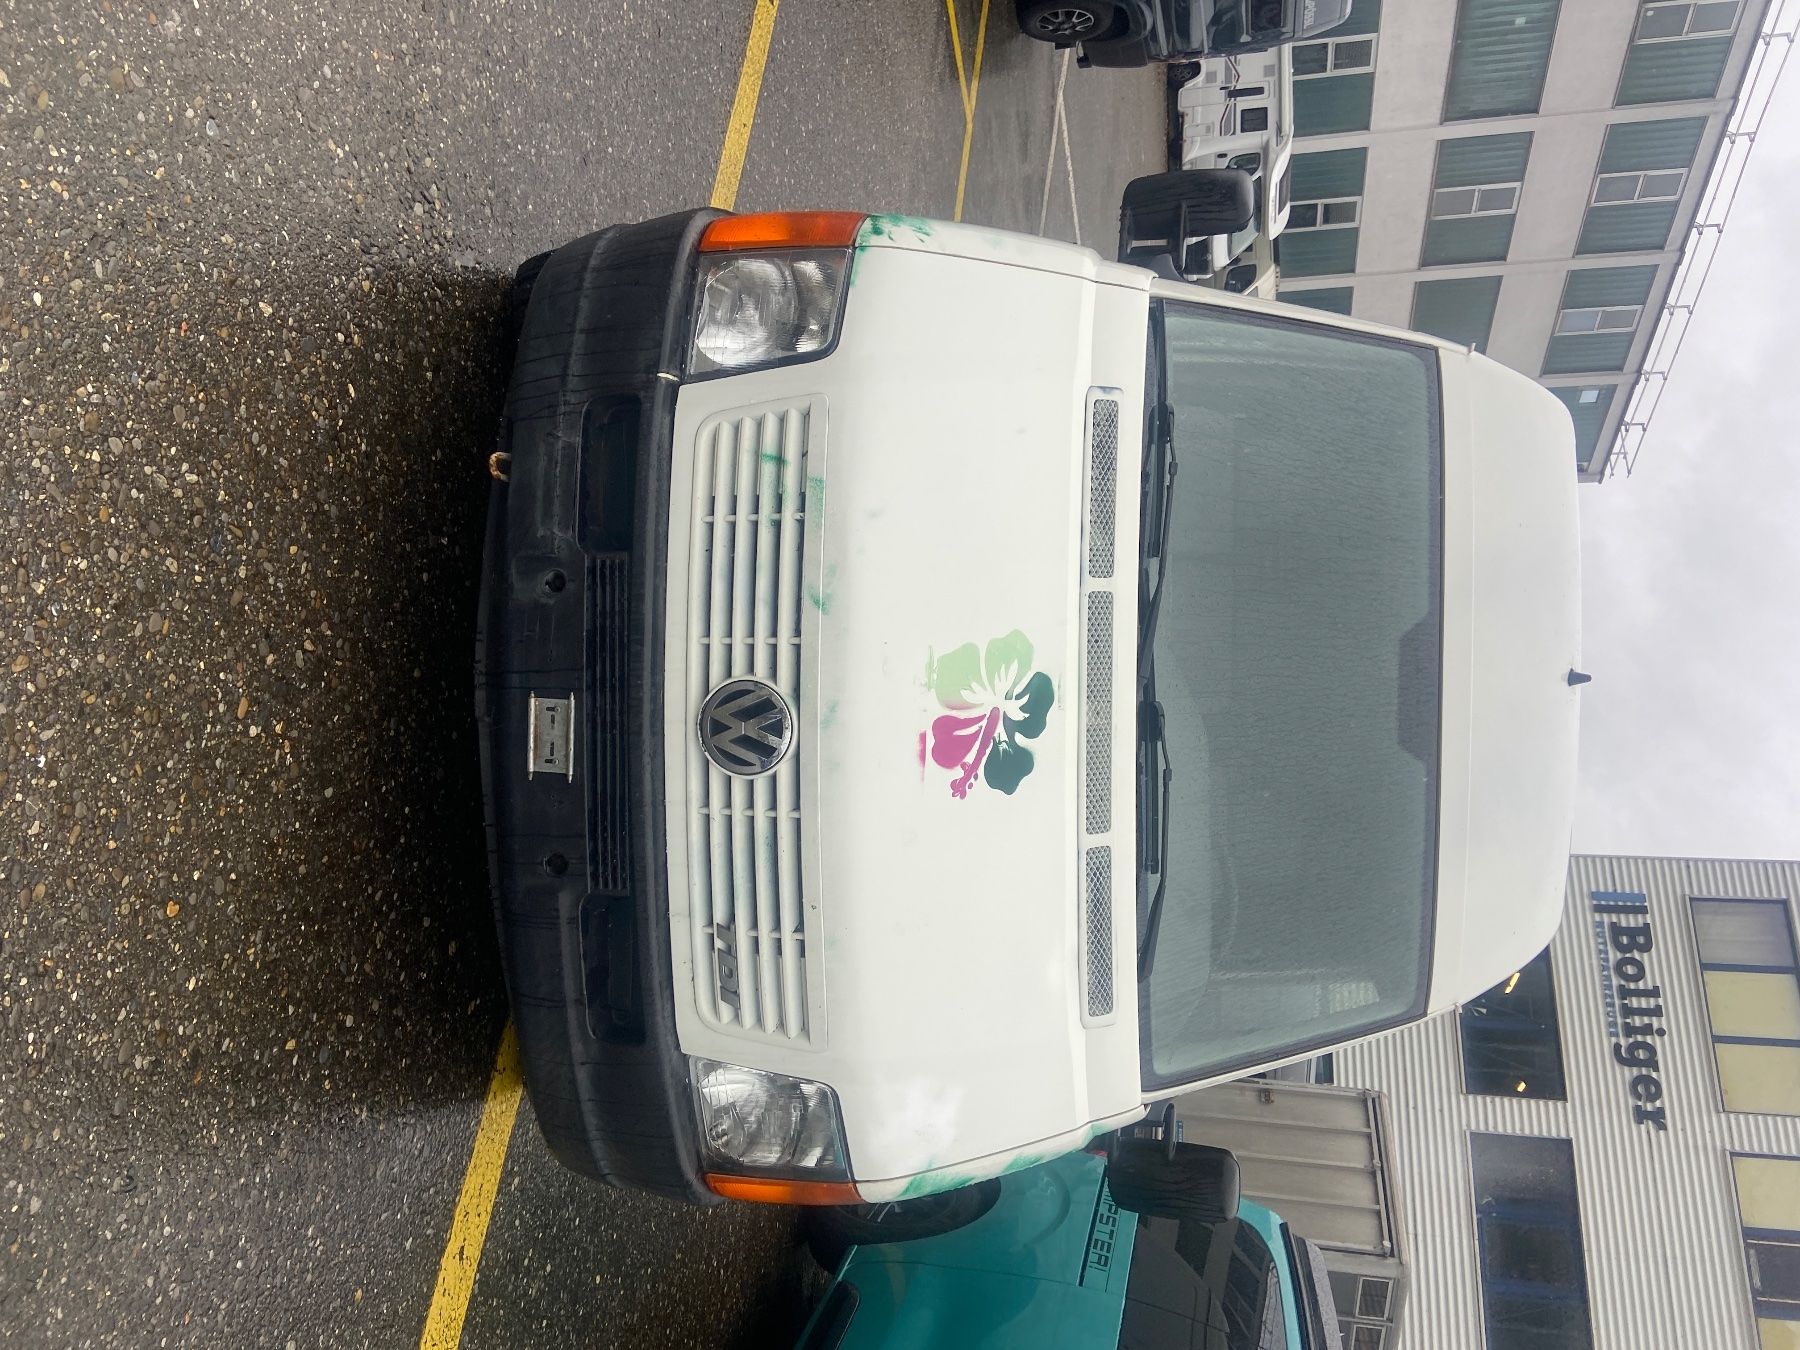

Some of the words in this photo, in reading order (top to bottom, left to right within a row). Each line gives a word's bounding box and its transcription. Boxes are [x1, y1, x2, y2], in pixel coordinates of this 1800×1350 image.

[704, 685, 789, 772] VW
[716, 921, 740, 1010] TDI
[1609, 921, 1668, 1132] Bolliger
